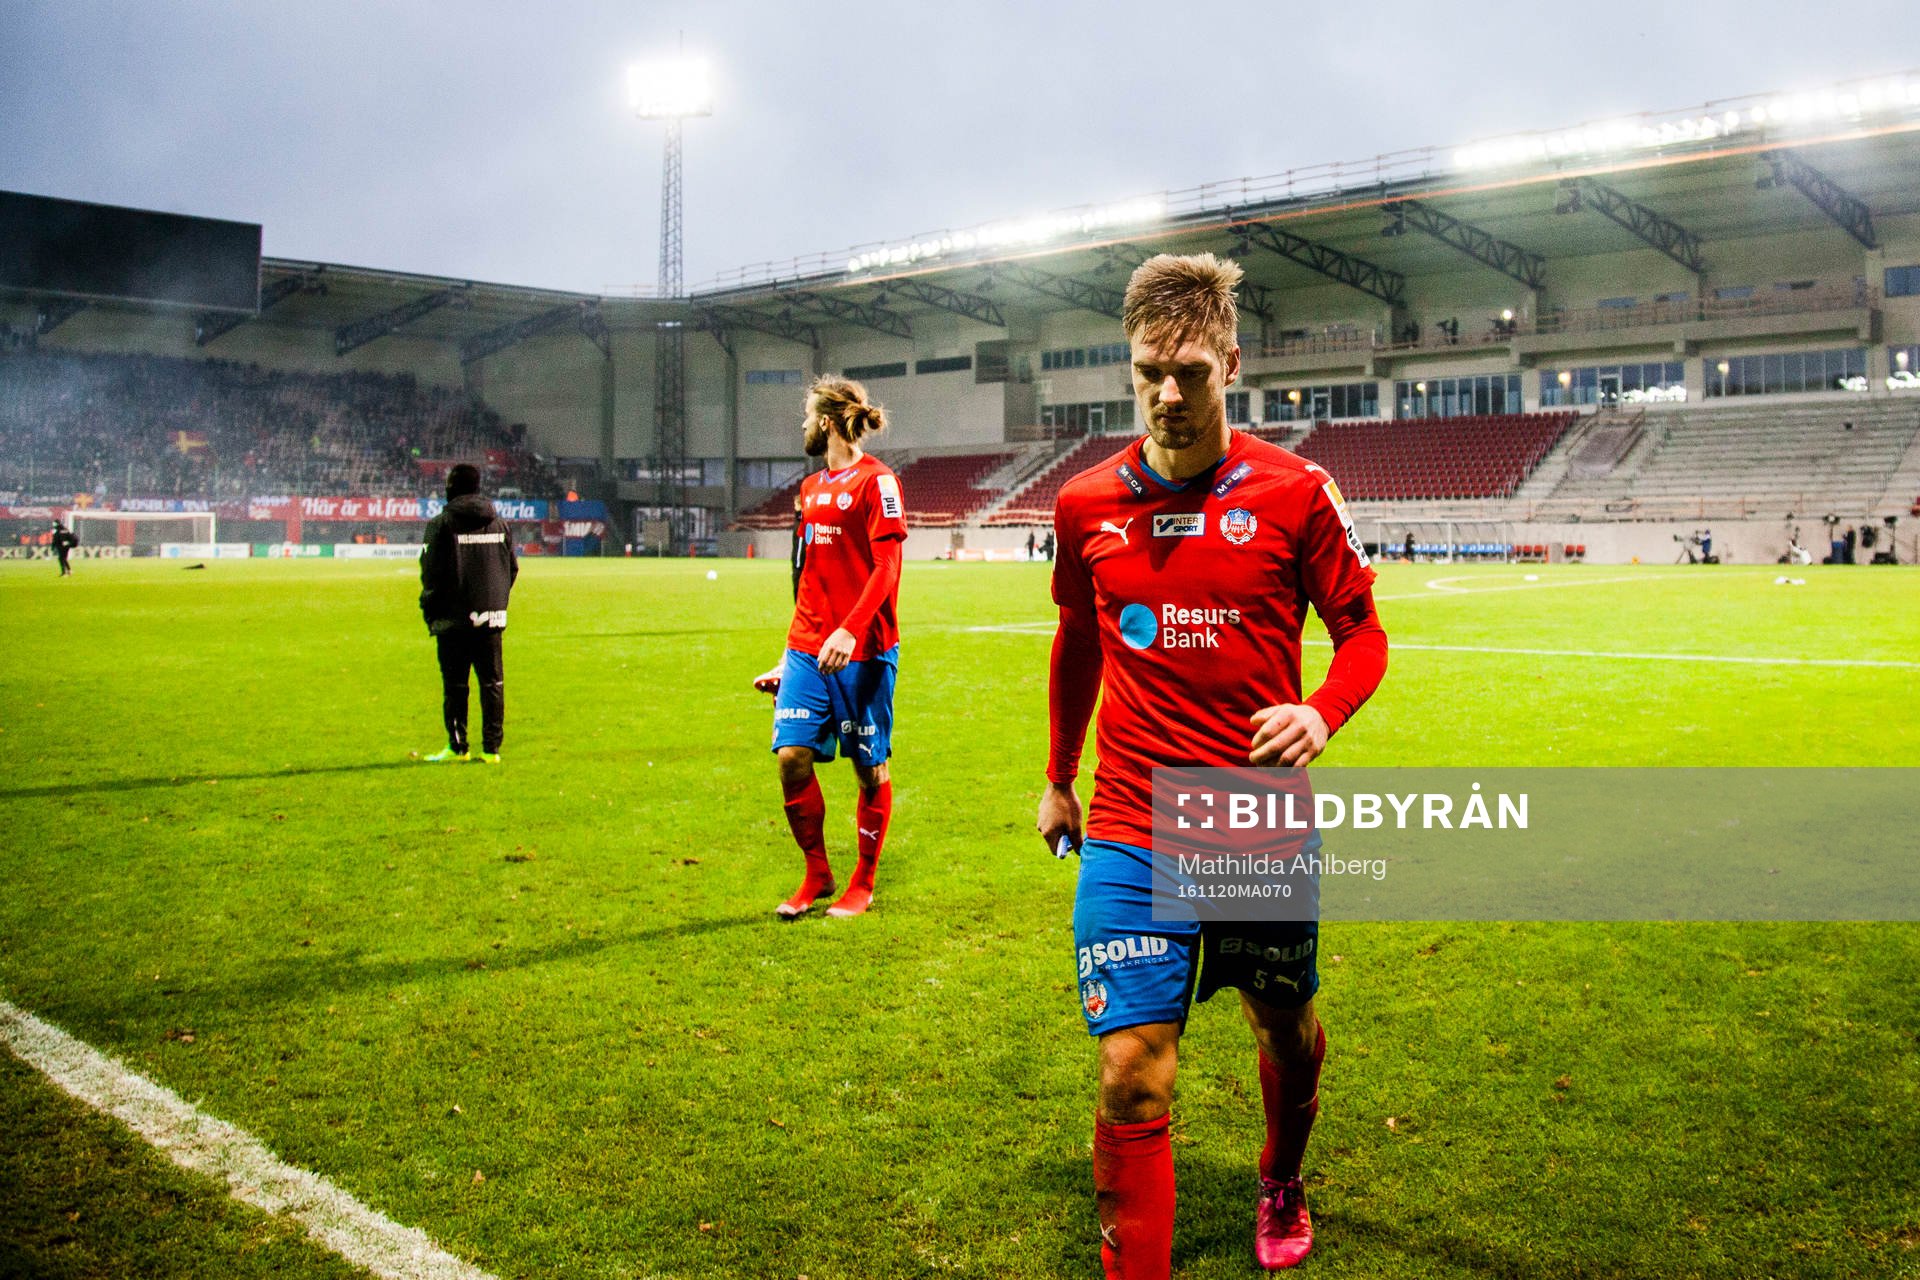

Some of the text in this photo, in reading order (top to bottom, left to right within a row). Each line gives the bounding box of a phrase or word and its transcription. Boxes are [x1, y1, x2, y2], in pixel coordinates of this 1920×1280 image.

[302, 498, 337, 516] Här
[341, 499, 361, 516] är
[368, 500, 381, 516] vi
[384, 499, 421, 518] från
[815, 523, 842, 535] Resurs
[1173, 517, 1199, 525] INTER
[815, 534, 833, 544] Bank
[1162, 603, 1241, 625] Resurs
[1163, 628, 1219, 649] Bank
[1092, 936, 1169, 966] SOLID
[1245, 938, 1313, 962] SOLID
[1253, 969, 1268, 990] 5
